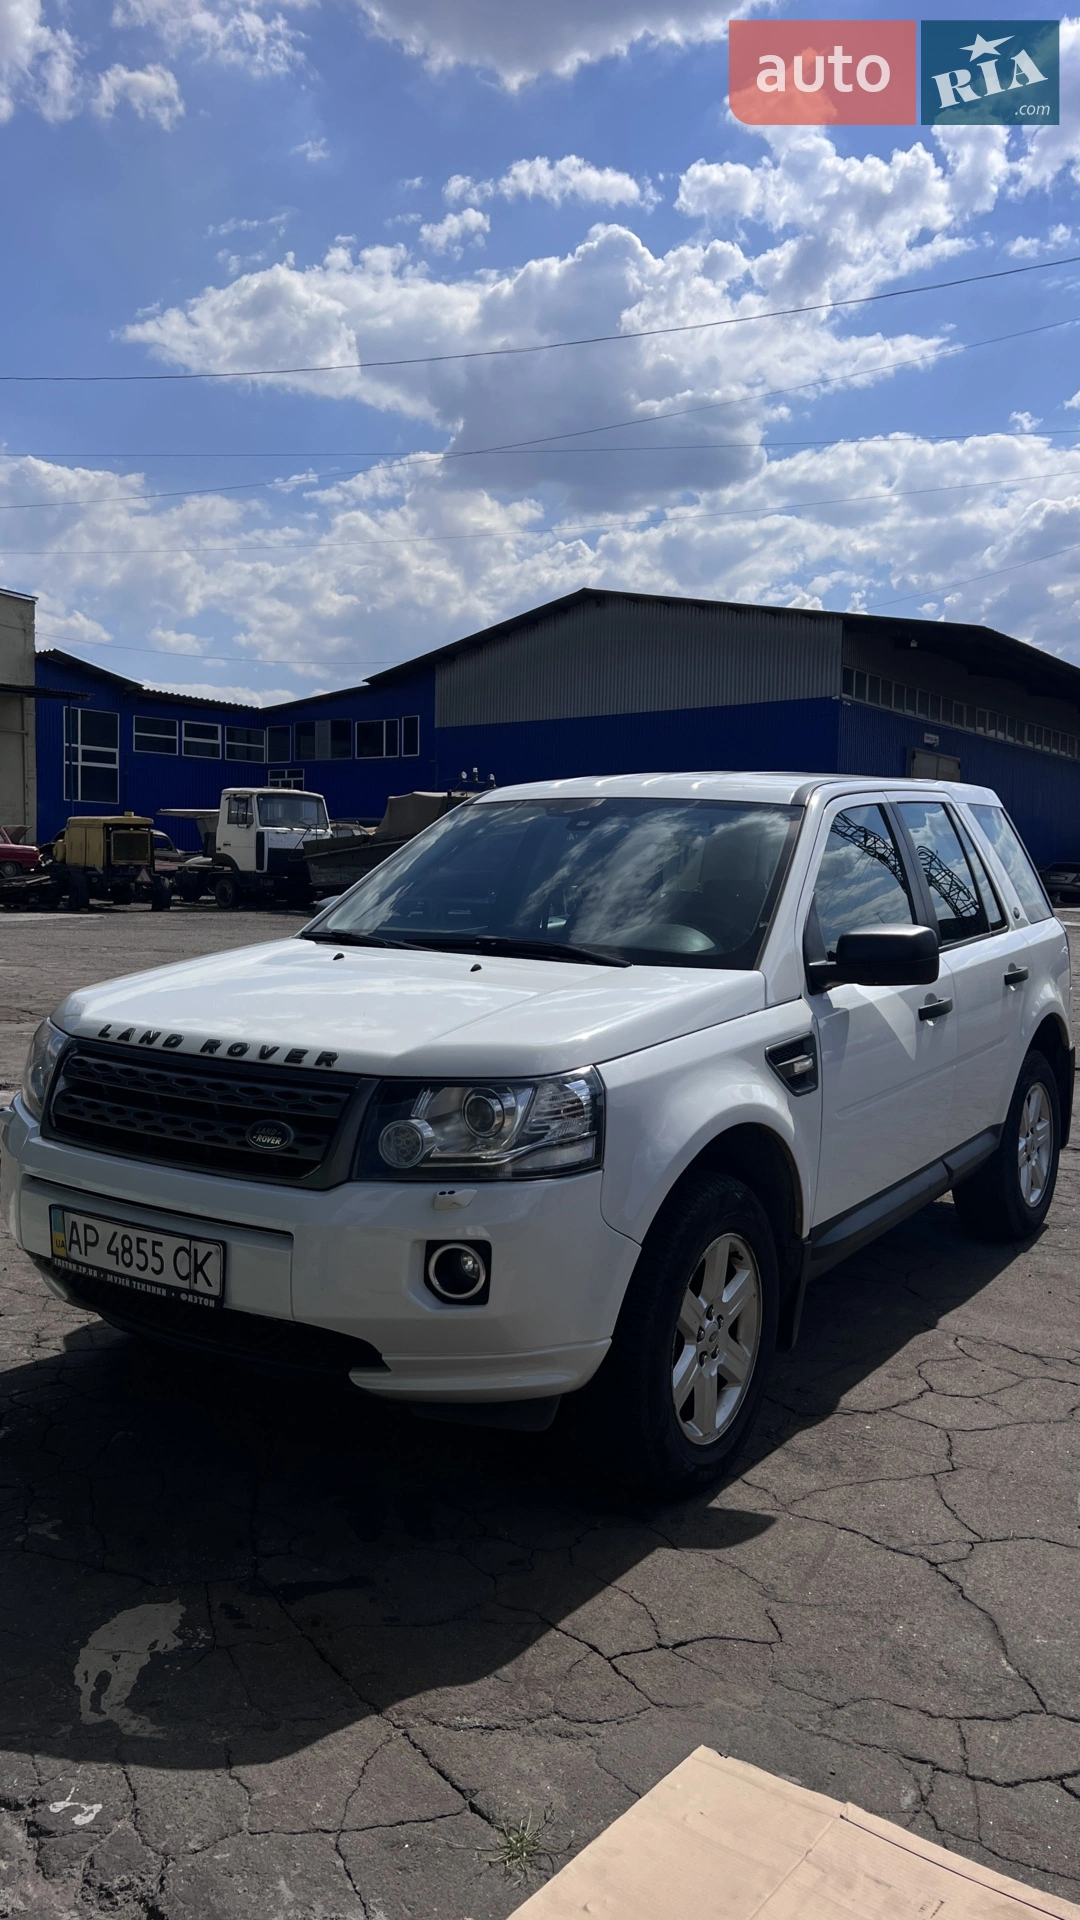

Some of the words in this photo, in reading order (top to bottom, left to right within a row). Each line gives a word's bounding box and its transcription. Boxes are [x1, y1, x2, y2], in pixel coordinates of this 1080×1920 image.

[98, 1024, 184, 1048] LAND
[200, 1039, 339, 1067] ROVER
[255, 1134, 282, 1145] ROVER
[55, 1239, 65, 1249] UA
[68, 1221, 99, 1257] AP
[106, 1231, 164, 1275] 4855
[173, 1246, 213, 1287] CK
